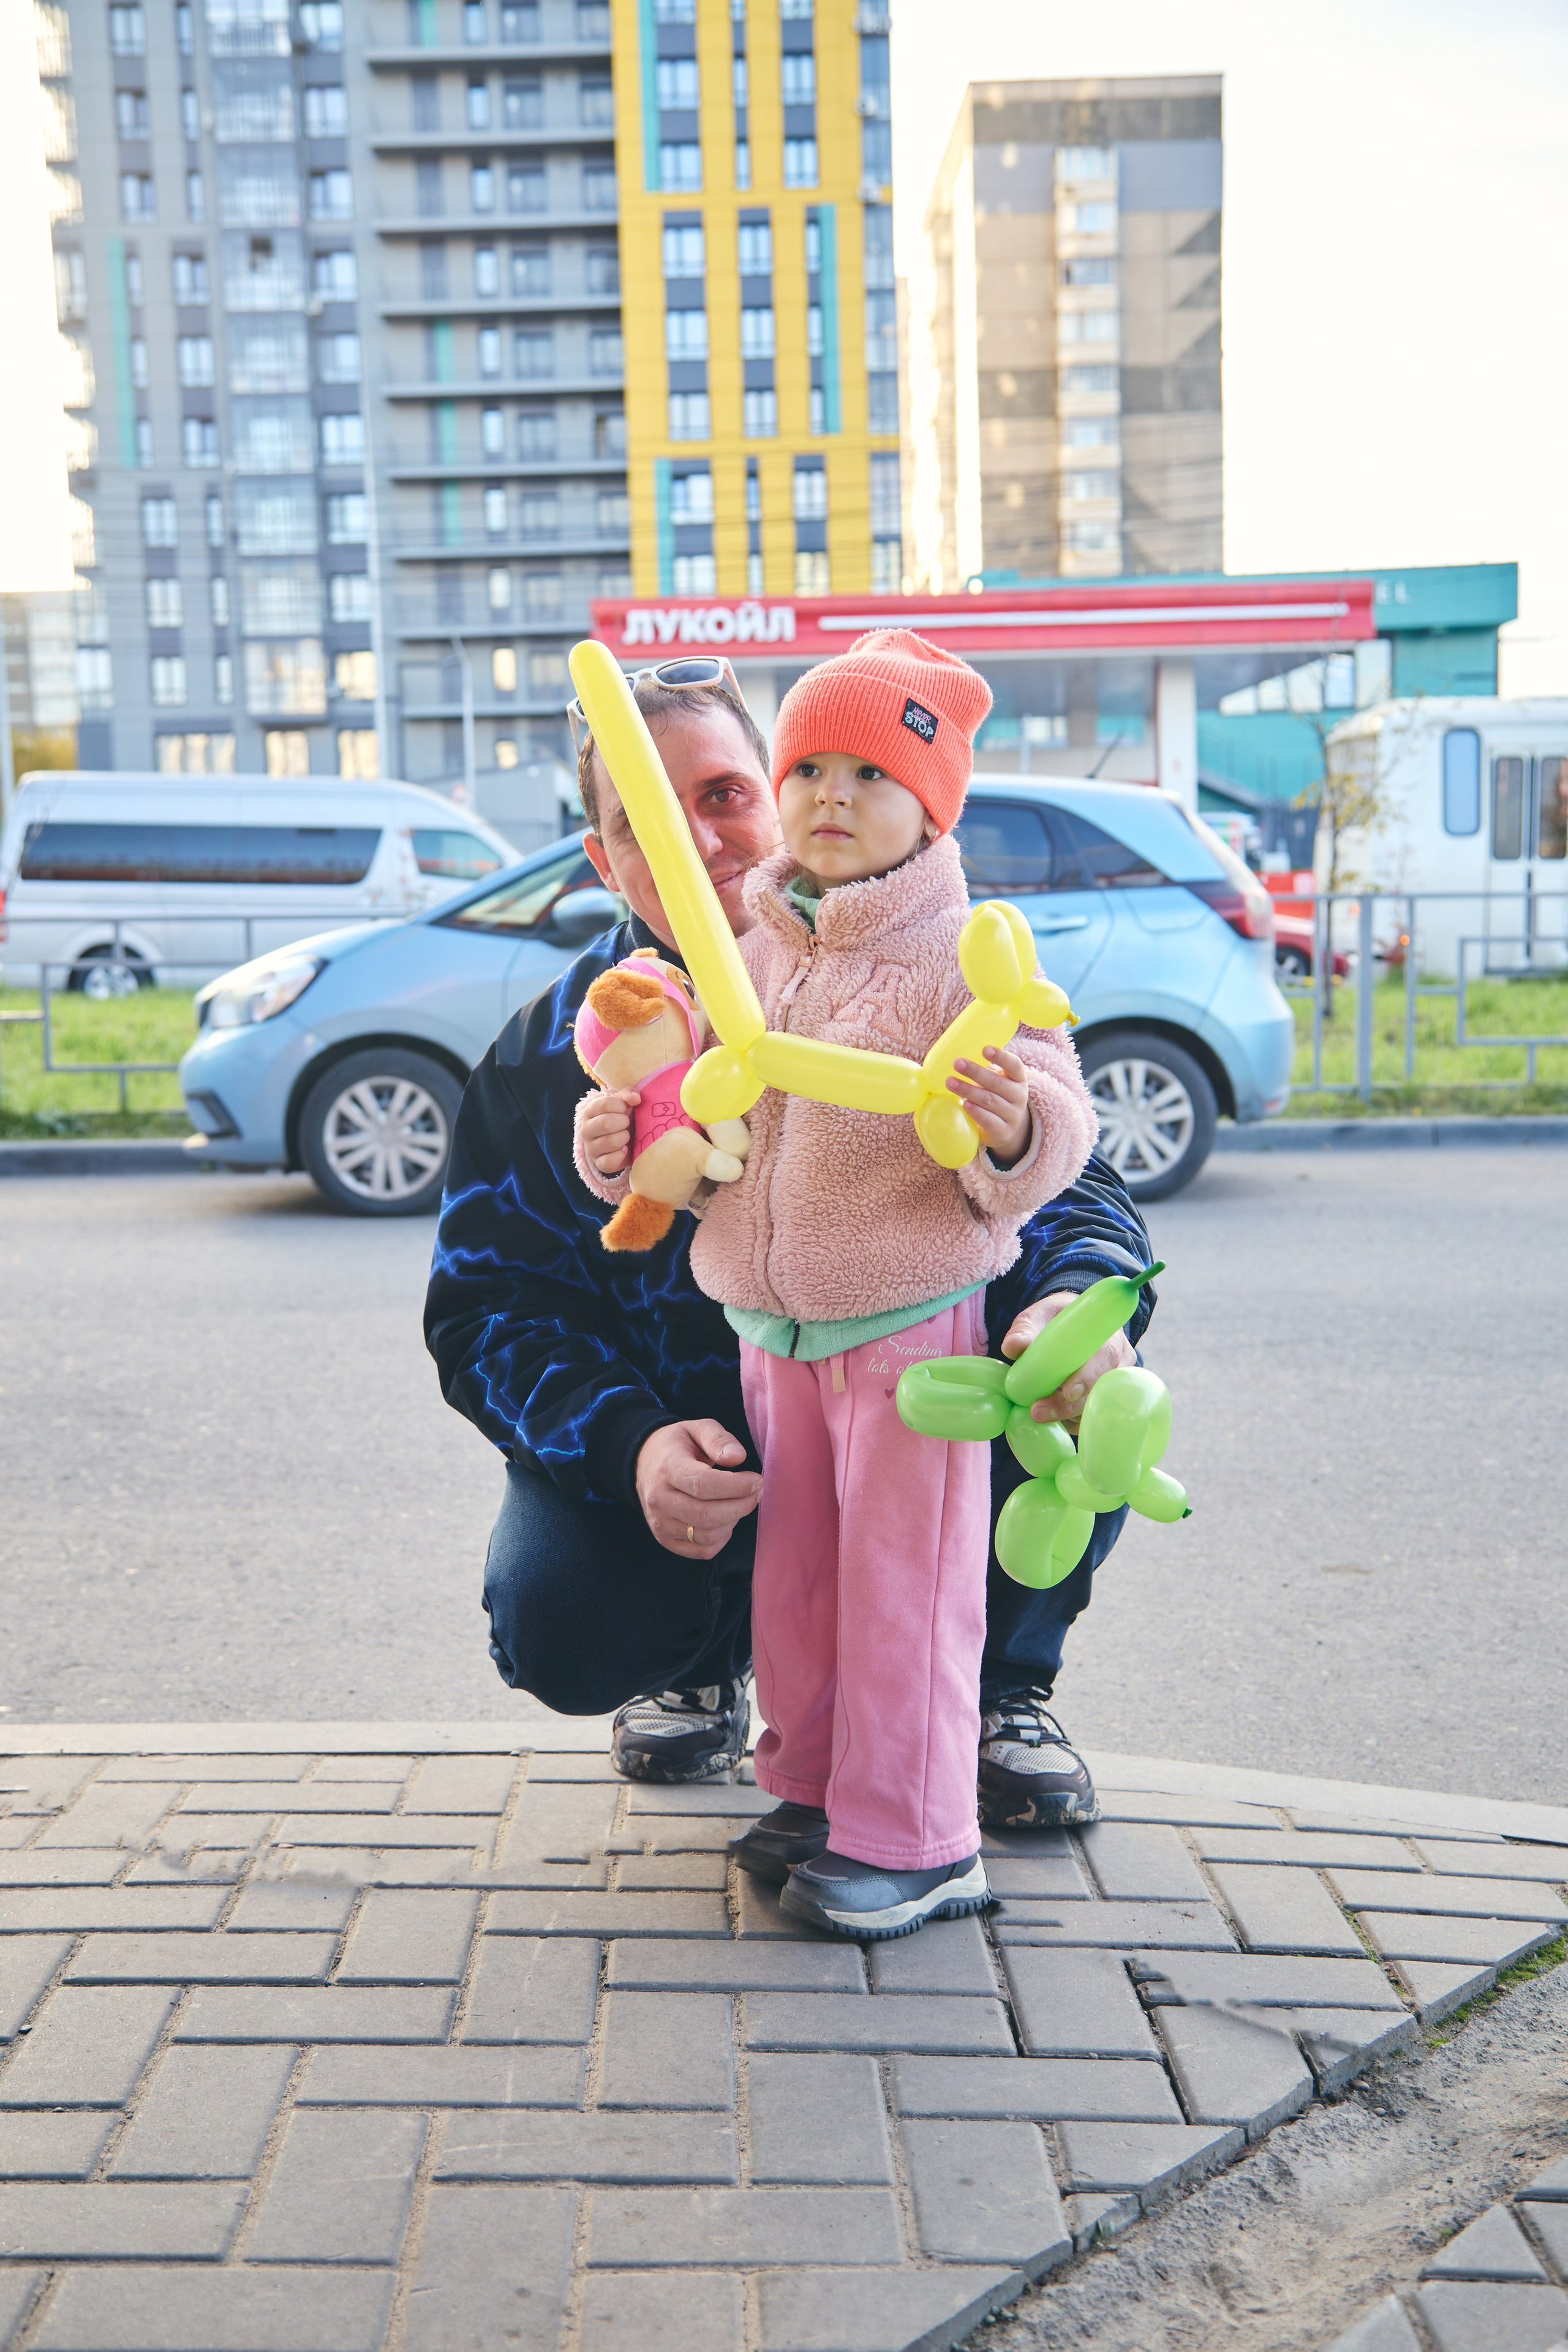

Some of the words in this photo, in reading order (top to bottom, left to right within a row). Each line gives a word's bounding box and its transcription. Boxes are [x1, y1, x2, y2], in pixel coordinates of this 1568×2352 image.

[621, 600, 796, 645] ЛУКОЙЛ
[905, 710, 934, 737] STOP
[878, 1335, 942, 1358] Sending
